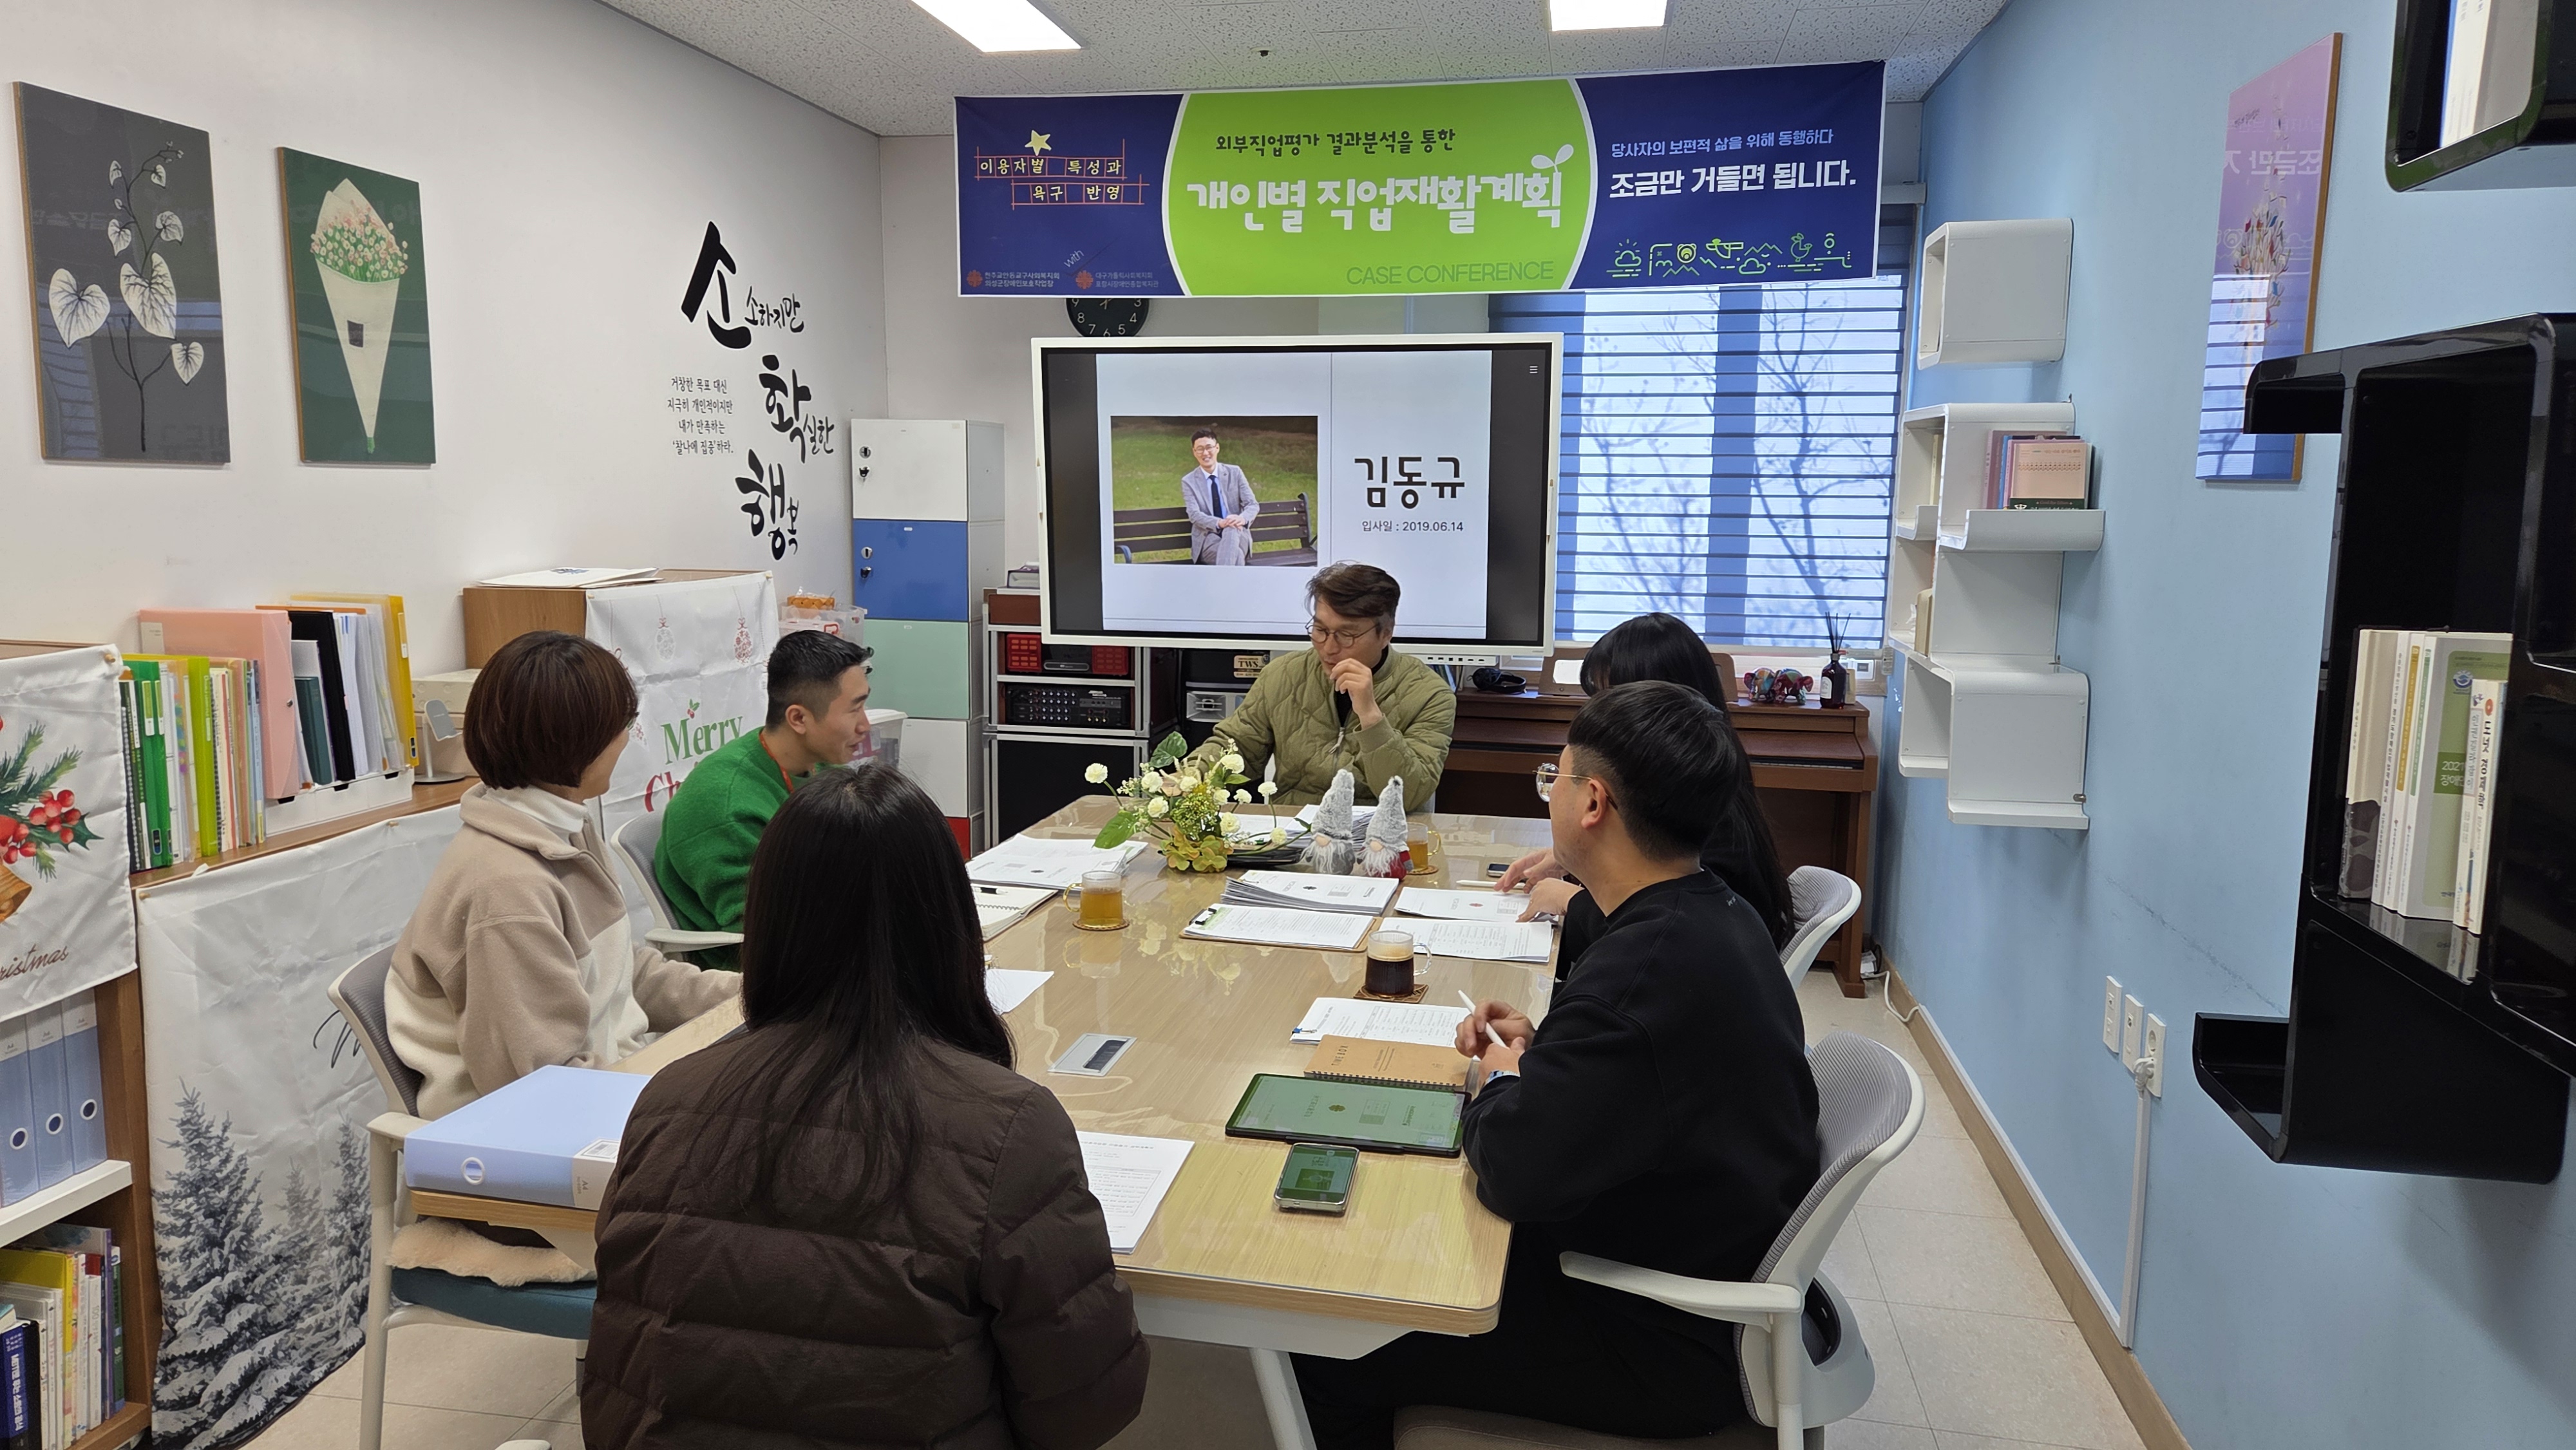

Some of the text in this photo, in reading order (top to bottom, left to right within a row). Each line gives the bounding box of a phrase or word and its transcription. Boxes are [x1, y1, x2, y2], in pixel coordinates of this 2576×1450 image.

[1216, 128, 1456, 156] 외부직업평가 결과분석을 통한
[1611, 128, 1833, 158] 당사자의 보편적 삶을 위해 동행하다
[980, 158, 1122, 174] 이용자별 특성과
[1610, 160, 1857, 199] 조금만 거들면 됩니다.
[1032, 185, 1121, 201] 욕구 반영
[1187, 171, 1563, 234] 개인별 직업재활계획
[1064, 249, 1084, 268] with
[1346, 261, 1554, 286] CASE CONFERENCE
[1077, 312, 1085, 323] 8
[1130, 312, 1137, 323] 4
[1088, 324, 1096, 334] 7
[1118, 324, 1126, 335] 5
[671, 376, 728, 394] 거창한 목표 대신
[667, 397, 733, 414] 지극히 개인적이지만
[679, 419, 726, 435] 내가 만족하는
[1354, 457, 1465, 509] 김동규
[1362, 520, 1394, 533] 입사일
[1403, 520, 1464, 532] 2019.06.14
[661, 716, 743, 765] Merry
[582, 1180, 589, 1191] A4
